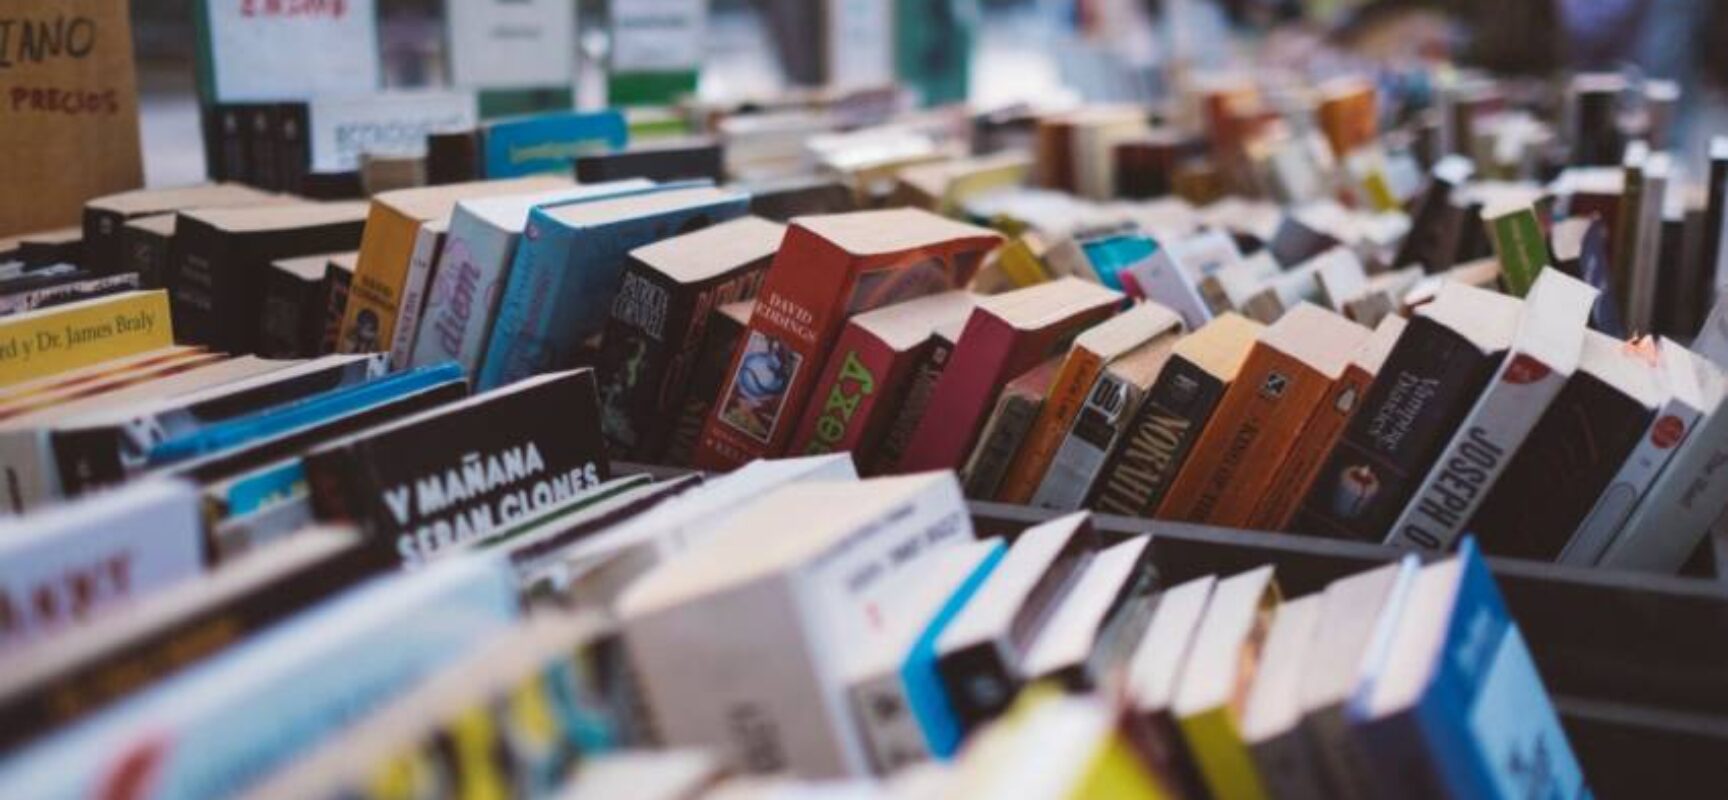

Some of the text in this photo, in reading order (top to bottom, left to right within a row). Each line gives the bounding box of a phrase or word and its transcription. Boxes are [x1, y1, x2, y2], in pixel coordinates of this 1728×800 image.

[9, 86, 119, 115] PRECIOS
[65, 325, 112, 349] James
[115, 311, 156, 336] Braly
[770, 293, 812, 324] DAVID
[416, 441, 544, 516] MAÑANA
[500, 462, 600, 524] CLONES
[1417, 427, 1504, 529] JOSEPH
